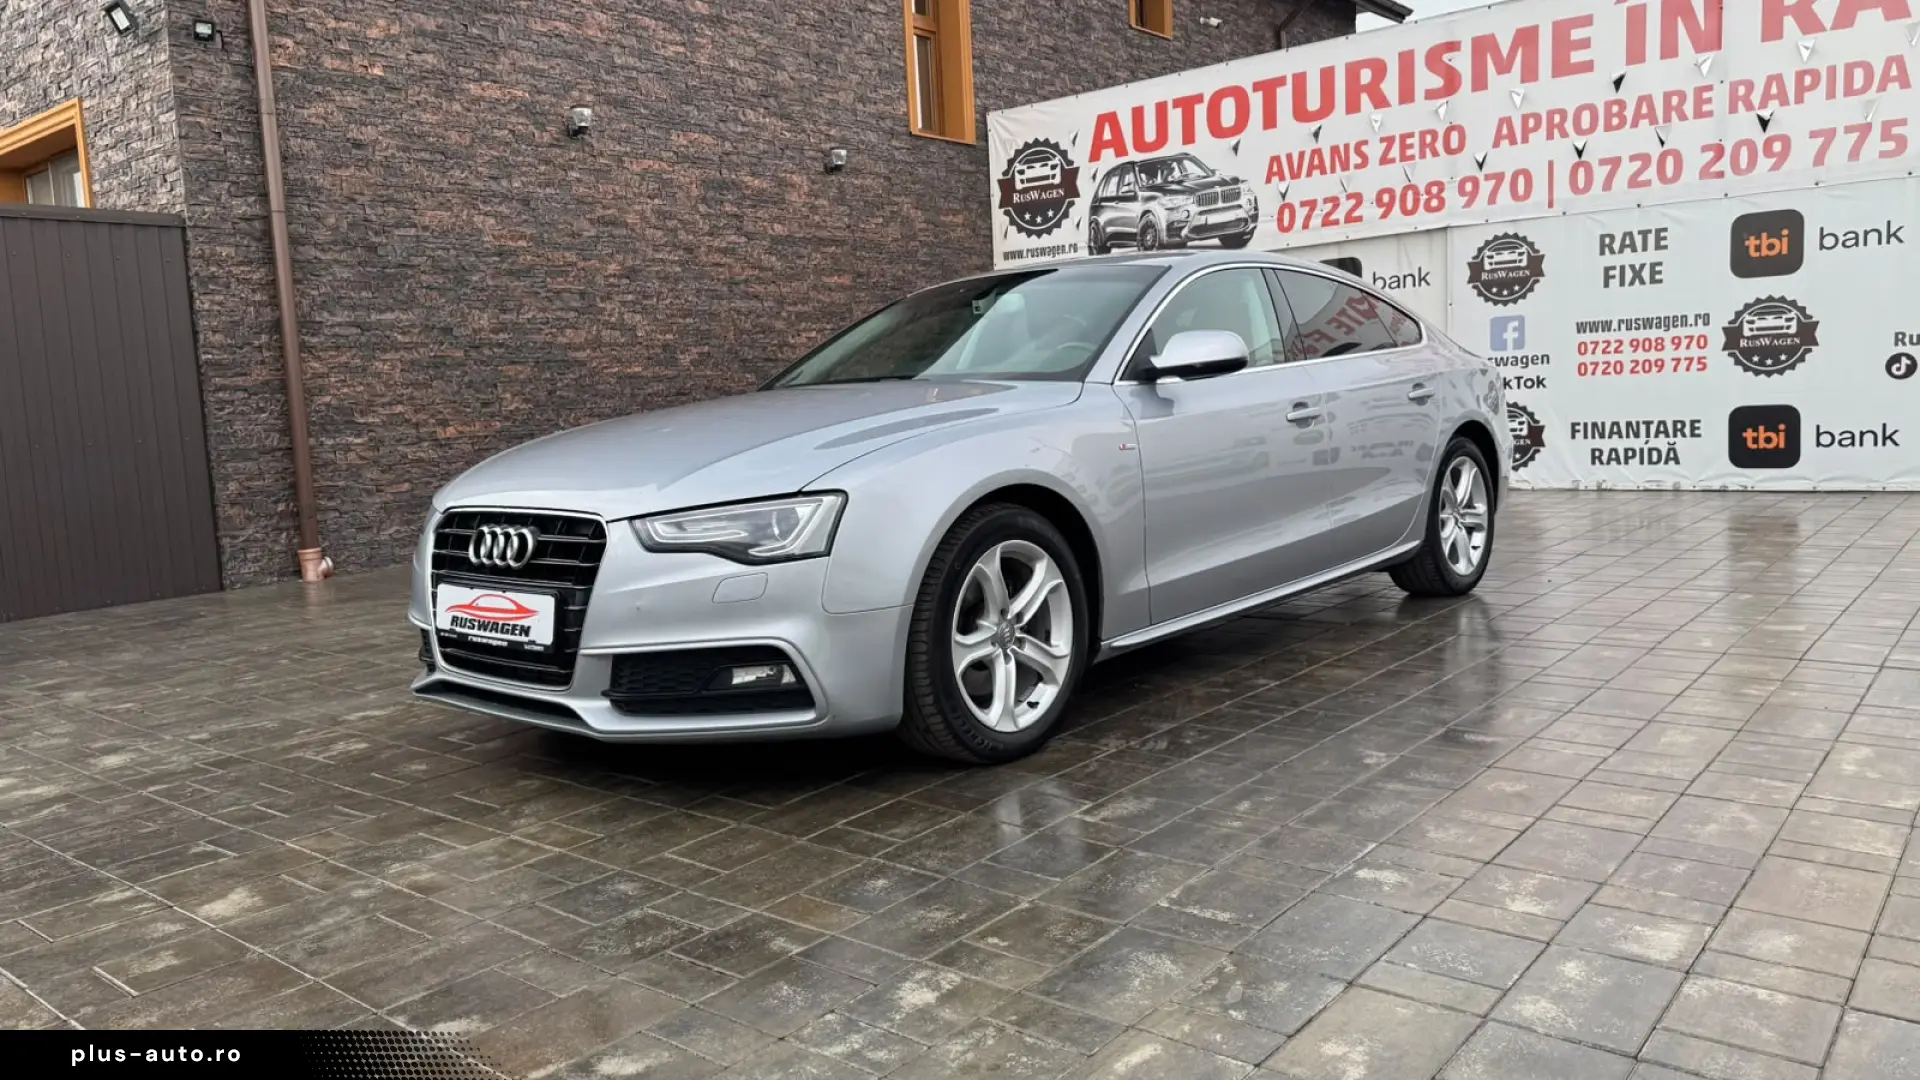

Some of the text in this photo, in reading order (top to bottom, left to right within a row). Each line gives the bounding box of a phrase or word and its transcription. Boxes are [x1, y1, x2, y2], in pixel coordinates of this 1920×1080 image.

[1088, 14, 1594, 162] AUTOTURISME
[1265, 54, 1911, 184] AVANS ZERO APROBARE RAPIDA
[1277, 192, 1363, 233] 0722
[1375, 178, 1447, 220] 908
[1458, 168, 1533, 209] 970
[1569, 148, 1683, 196] 0720
[1699, 133, 1791, 180] 209
[1809, 118, 1909, 168] 775
[1002, 243, 1078, 261] www.ruswagen.ro
[1599, 227, 1669, 256] RATE
[1745, 220, 1905, 258] tbi bank
[1373, 267, 1431, 290] bank
[1603, 261, 1663, 288] FIXE
[1576, 313, 1710, 334] www.ruswagen.ro
[1577, 334, 1708, 356] 0722 908 970
[1577, 356, 1708, 376] 0720 209 775
[1743, 423, 1900, 449] tbi bank
[451, 615, 531, 637] RUSWAGEN
